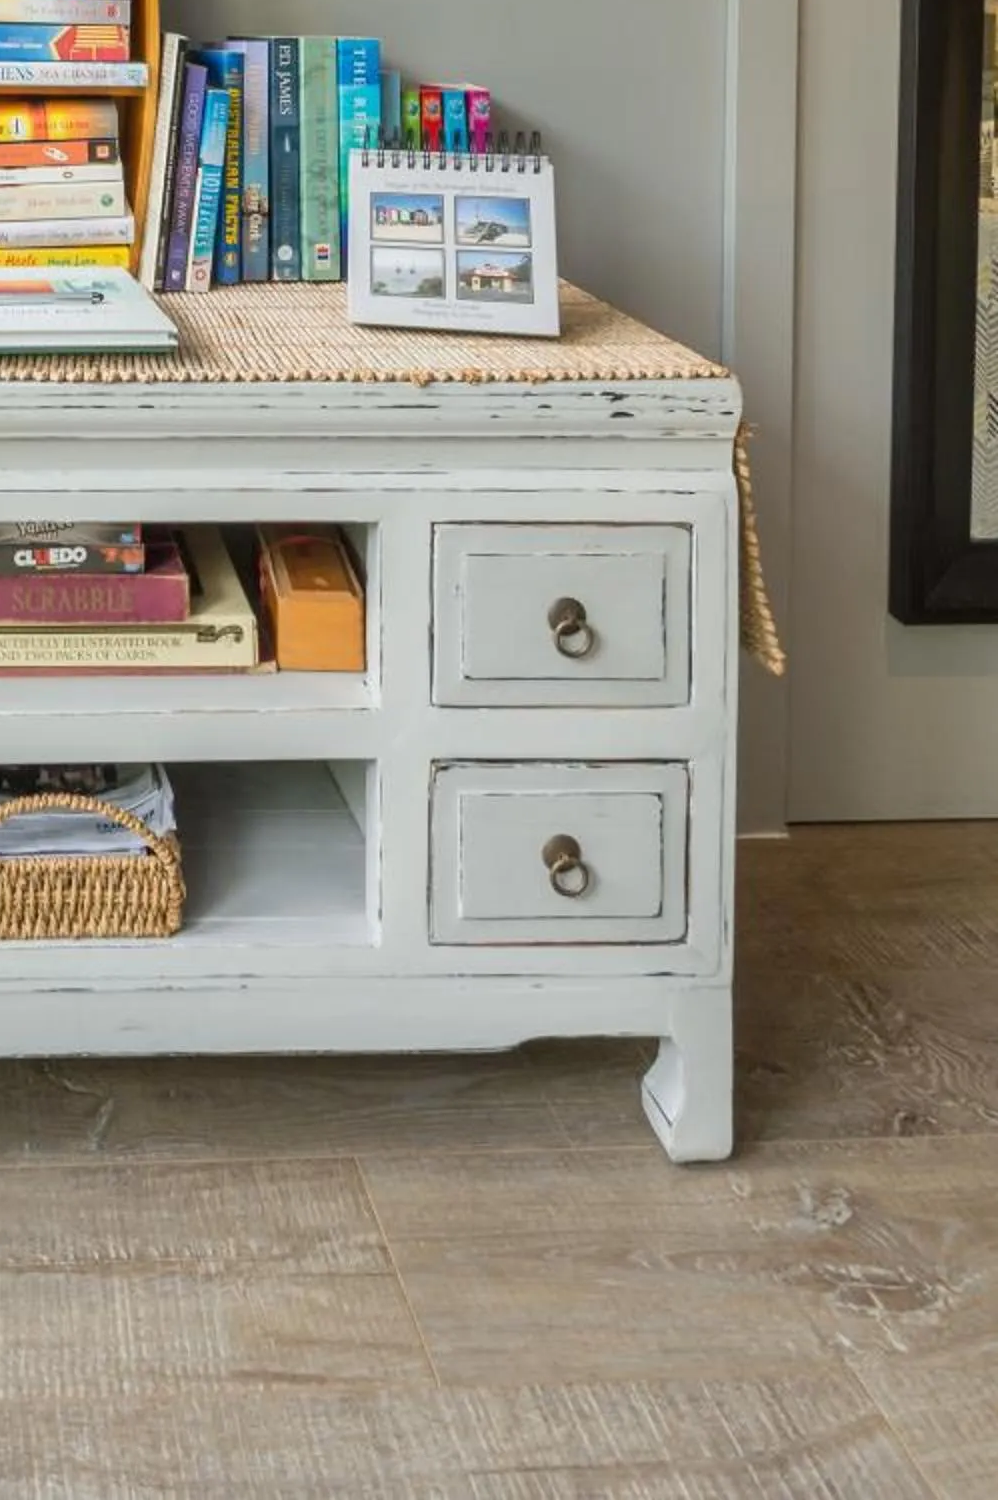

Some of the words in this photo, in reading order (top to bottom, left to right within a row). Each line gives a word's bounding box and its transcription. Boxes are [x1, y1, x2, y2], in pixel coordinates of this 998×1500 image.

[354, 48, 367, 88] THE
[186, 93, 200, 129] GOOD
[276, 71, 293, 116] JAMES
[226, 87, 242, 189] AUSTRALIAN
[180, 132, 196, 198] WEEKENDS
[202, 172, 221, 193] 101
[176, 200, 188, 236] AWAY
[225, 194, 240, 245] FACTS
[4, 254, 38, 267] Heels
[13, 545, 87, 567] CLUEDO
[11, 583, 134, 613] SCRABBLE
[24, 650, 53, 661] TWO
[55, 650, 93, 661] PACKS
[96, 650, 111, 661] OF
[63, 636, 145, 649] ILLUSTRATED
[147, 636, 184, 649] BOOK
